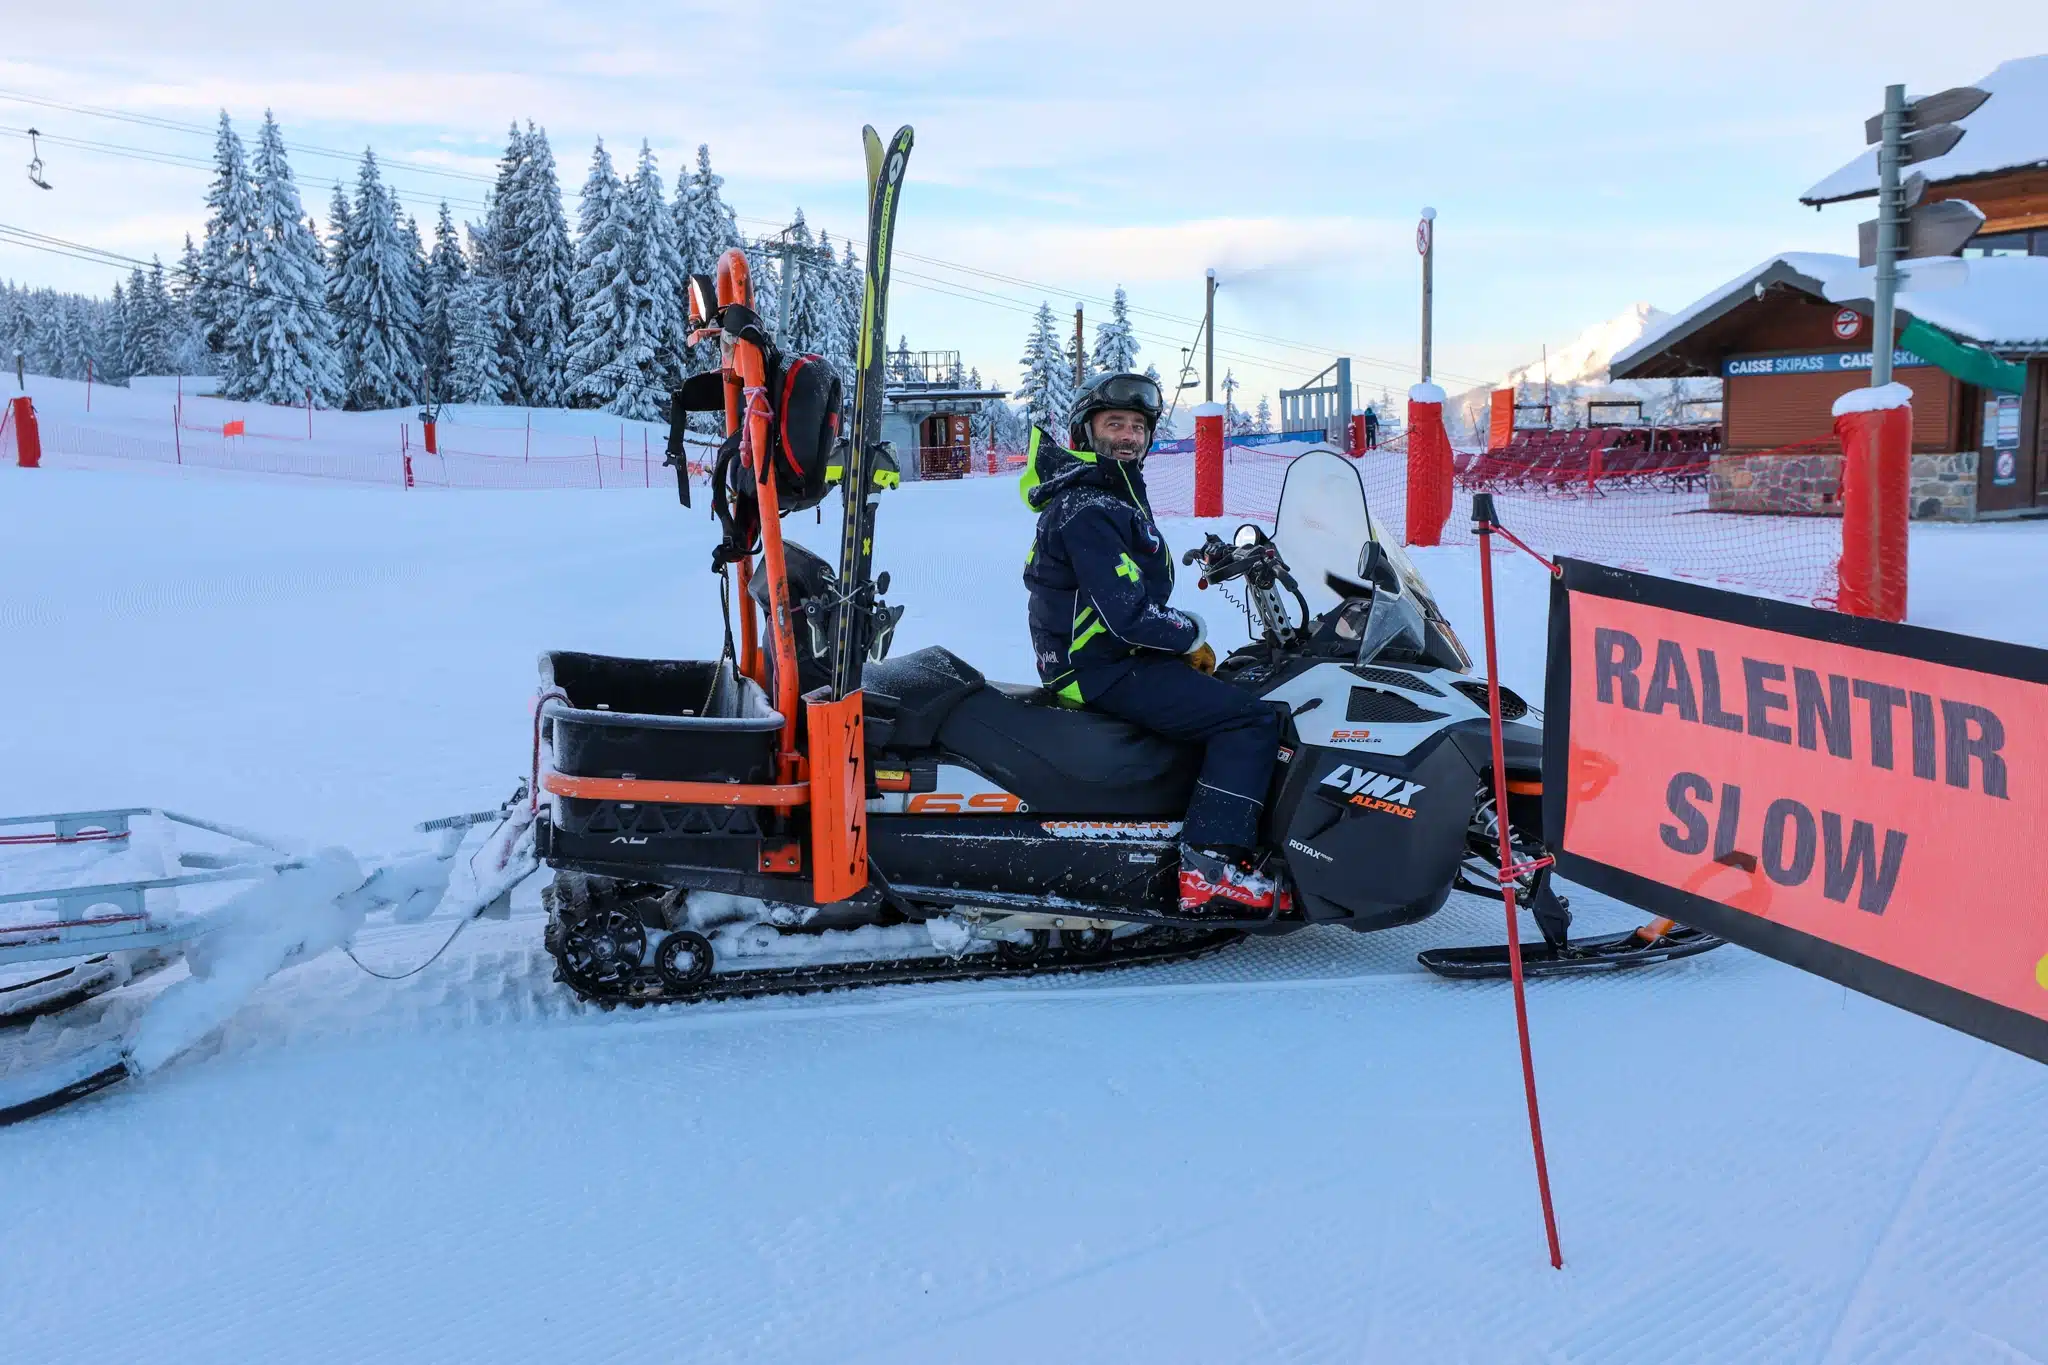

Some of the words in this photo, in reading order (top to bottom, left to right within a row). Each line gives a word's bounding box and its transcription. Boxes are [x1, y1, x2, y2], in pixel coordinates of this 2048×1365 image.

[880, 191, 891, 267] DYNASTAR
[1728, 359, 1773, 375] CAISSE
[1775, 355, 1824, 371] SKIPASS
[1839, 351, 1874, 369] CAIS
[1594, 626, 2011, 801] RALENTIR
[1331, 730, 1370, 738] 69
[1320, 764, 1427, 806] LYNX
[907, 793, 1024, 813] 69
[1349, 794, 1417, 819] ALPINE
[1289, 838, 1321, 860] ROTAX
[1659, 771, 1908, 917] SLOW
